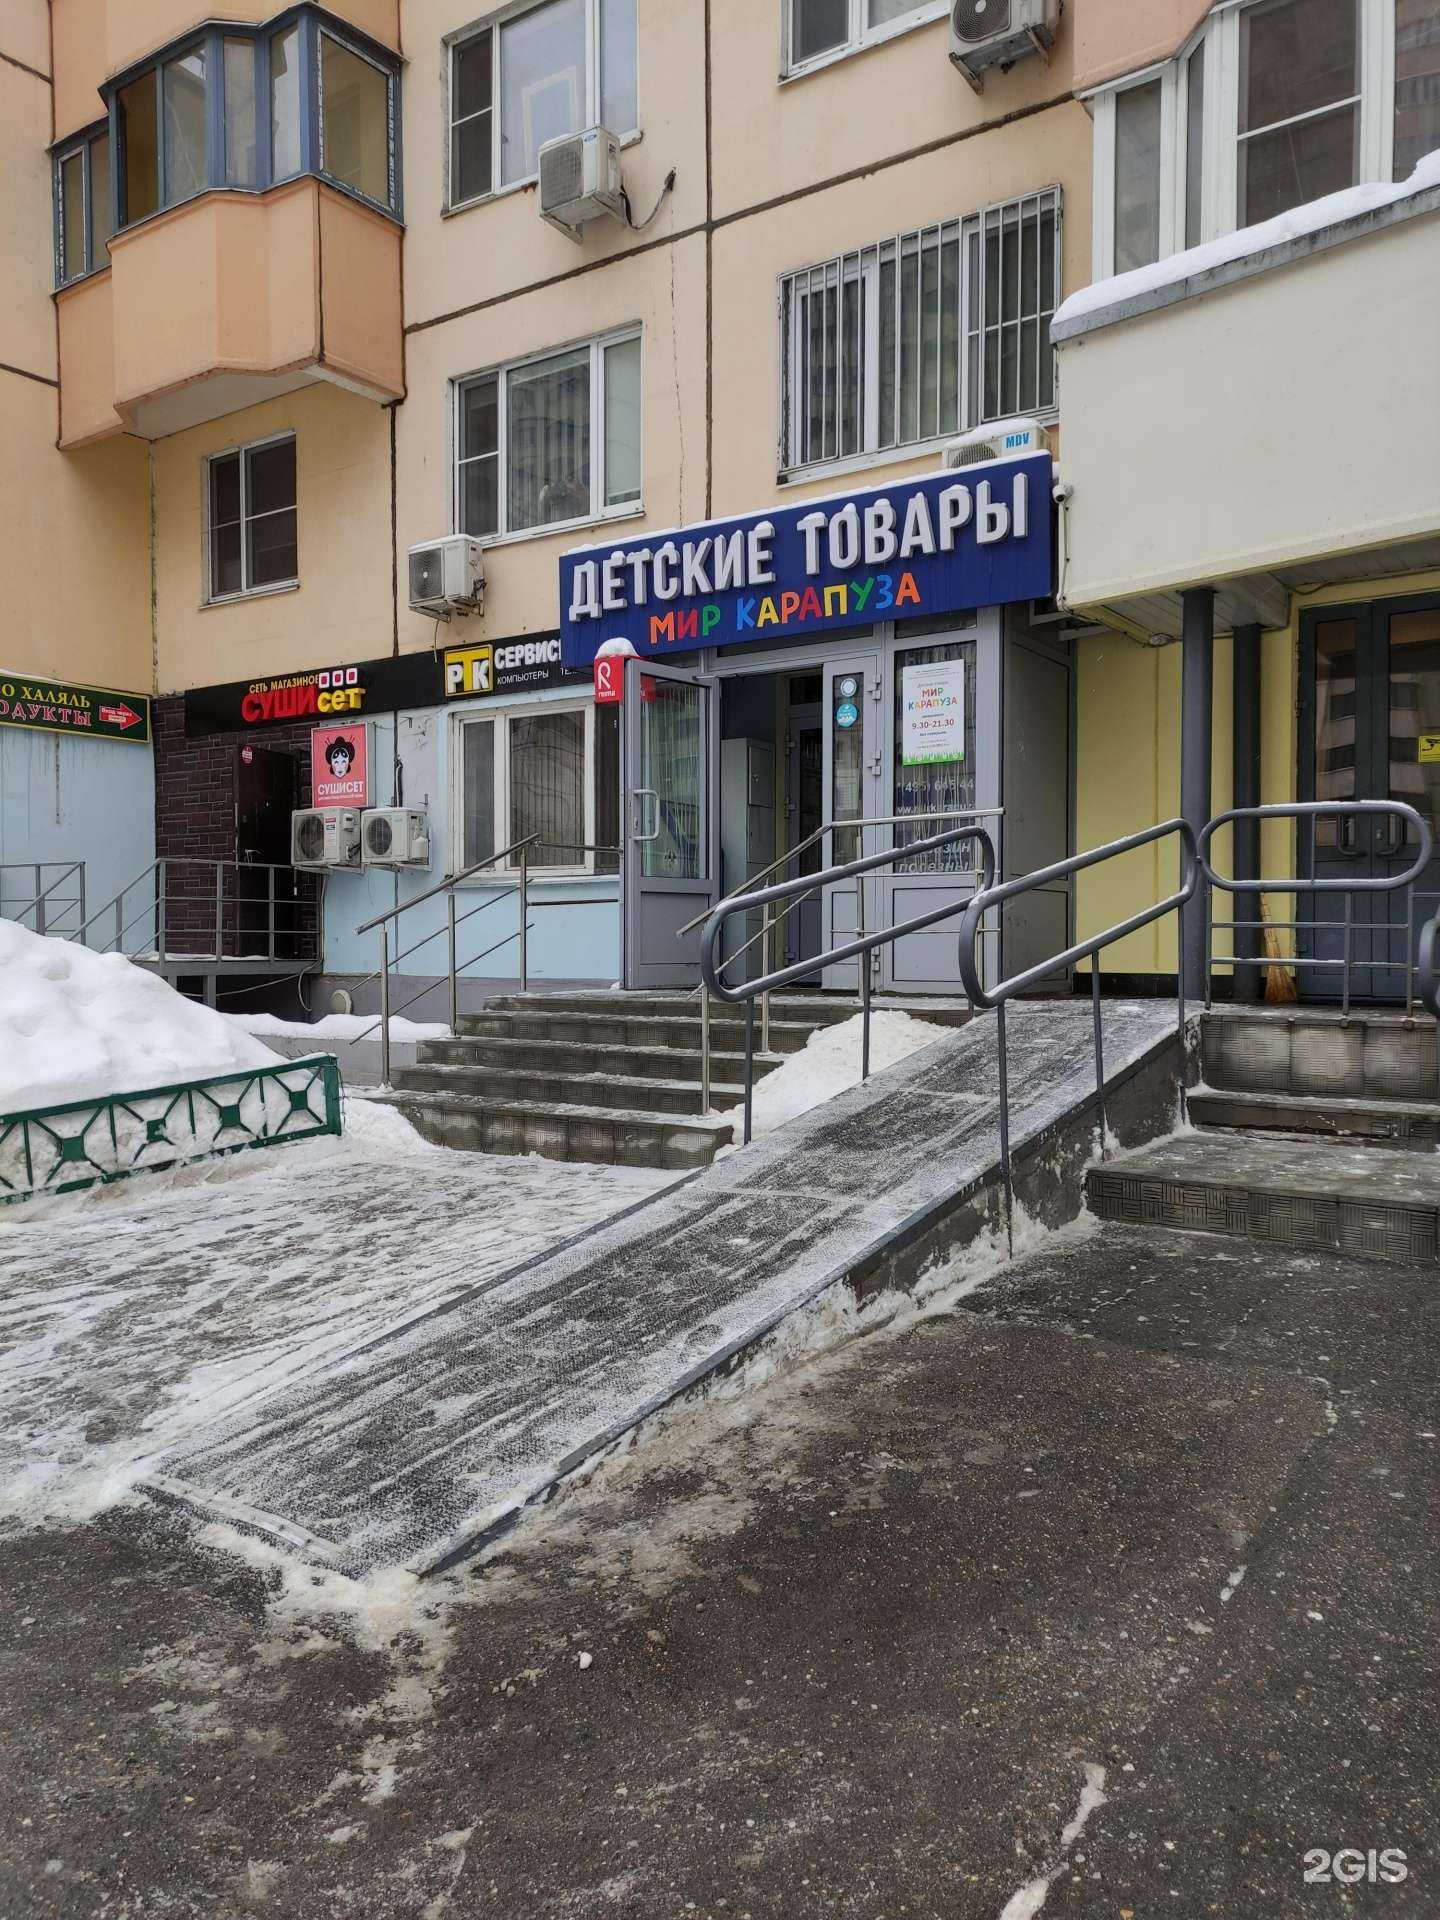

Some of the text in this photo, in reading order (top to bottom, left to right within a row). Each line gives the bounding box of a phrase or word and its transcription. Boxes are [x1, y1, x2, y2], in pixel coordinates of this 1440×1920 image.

[1006, 432, 1030, 448] MDV
[569, 472, 1029, 622] ДЕТСКИЕ ТОВАРЫ
[650, 572, 921, 644] МИР КАРАПУЗА
[494, 639, 561, 670] СЕРВИС
[446, 647, 491, 694] РТК
[497, 669, 549, 685] КОМПЬЮТЕРЫ
[249, 682, 268, 694] СЕТЬ
[922, 687, 944, 698] МИР
[20, 686, 91, 708] ХАЛЯЛЬ
[908, 696, 958, 711] КАРАПУЗА
[912, 718, 955, 730] 9.30-21.30
[318, 781, 364, 796] СУШИСЕТ
